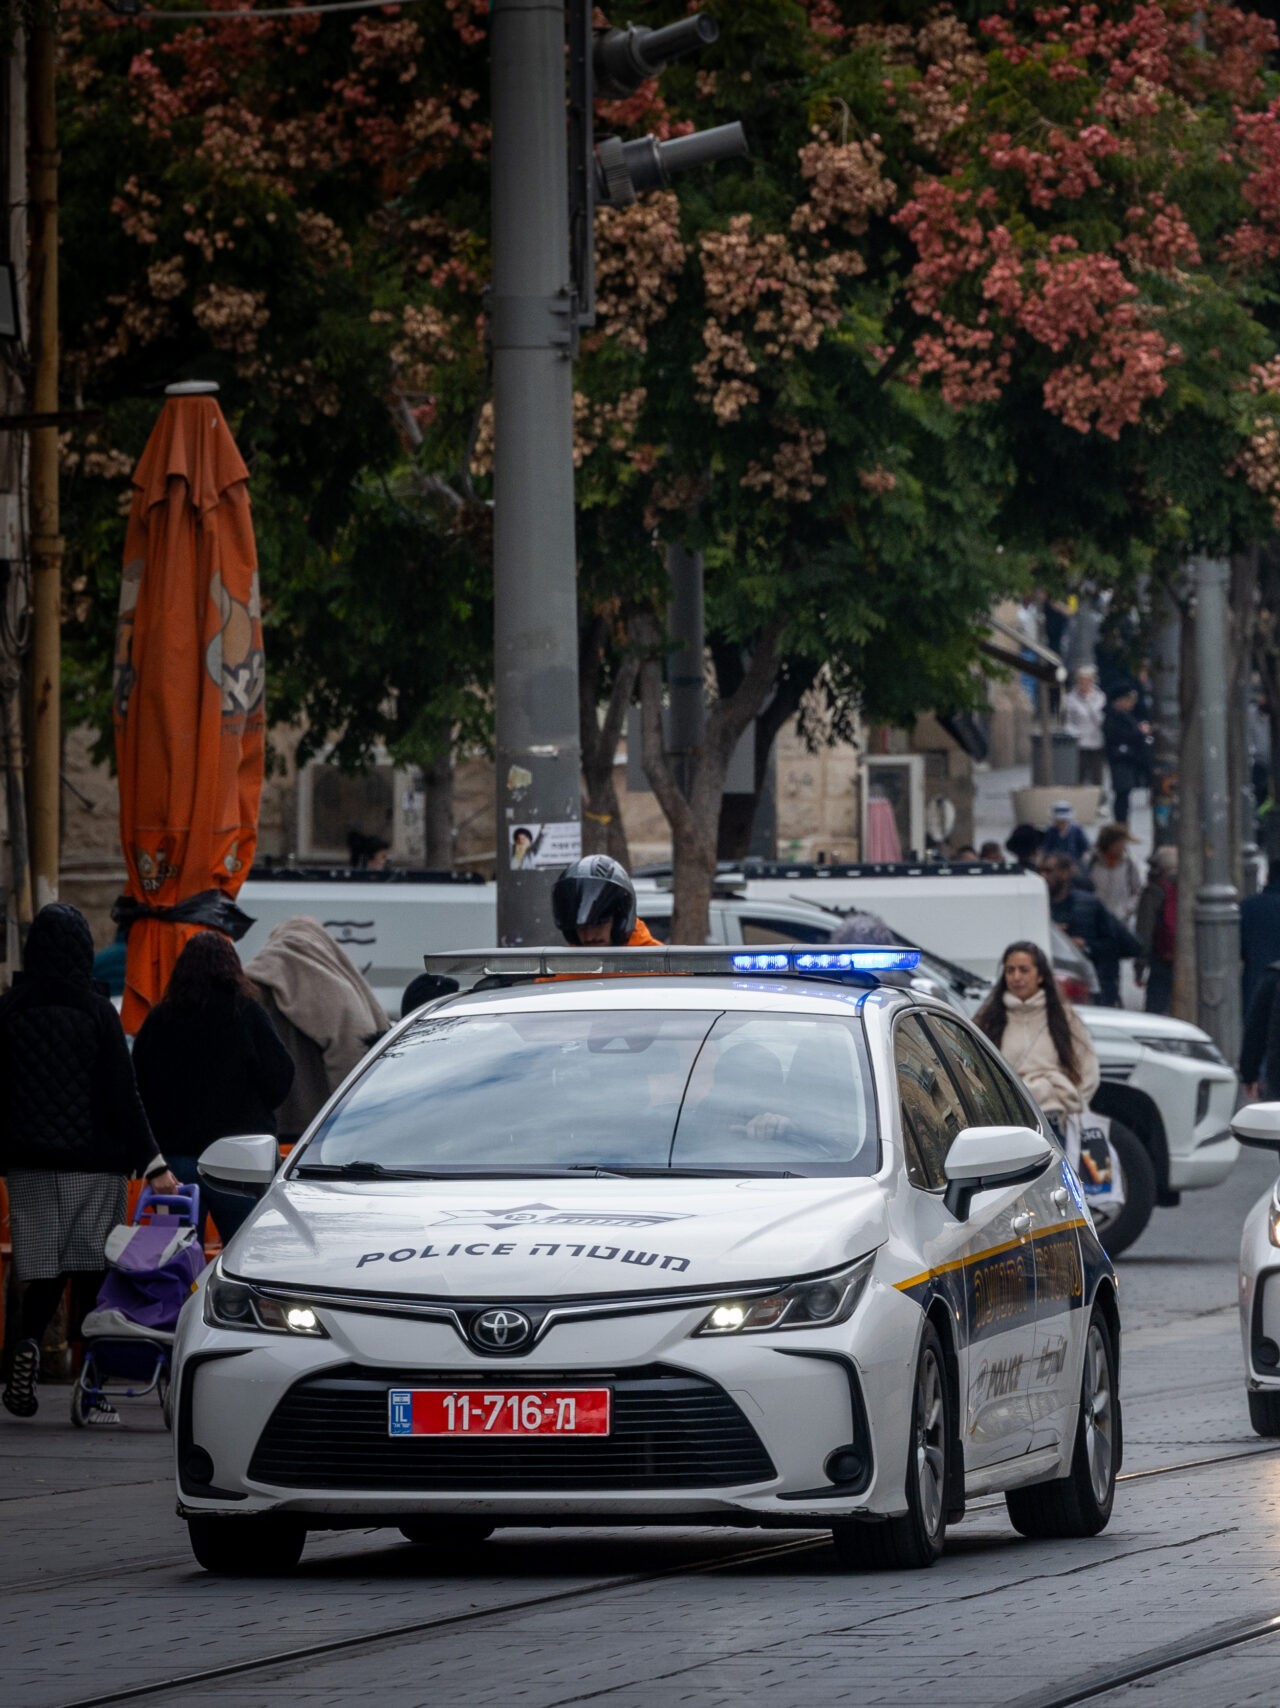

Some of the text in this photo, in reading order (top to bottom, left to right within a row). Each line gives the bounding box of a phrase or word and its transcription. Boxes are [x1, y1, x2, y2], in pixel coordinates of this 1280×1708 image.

[356, 1243, 517, 1268] POLICE
[530, 1243, 691, 1273] משטרה
[395, 1405, 408, 1423] IL
